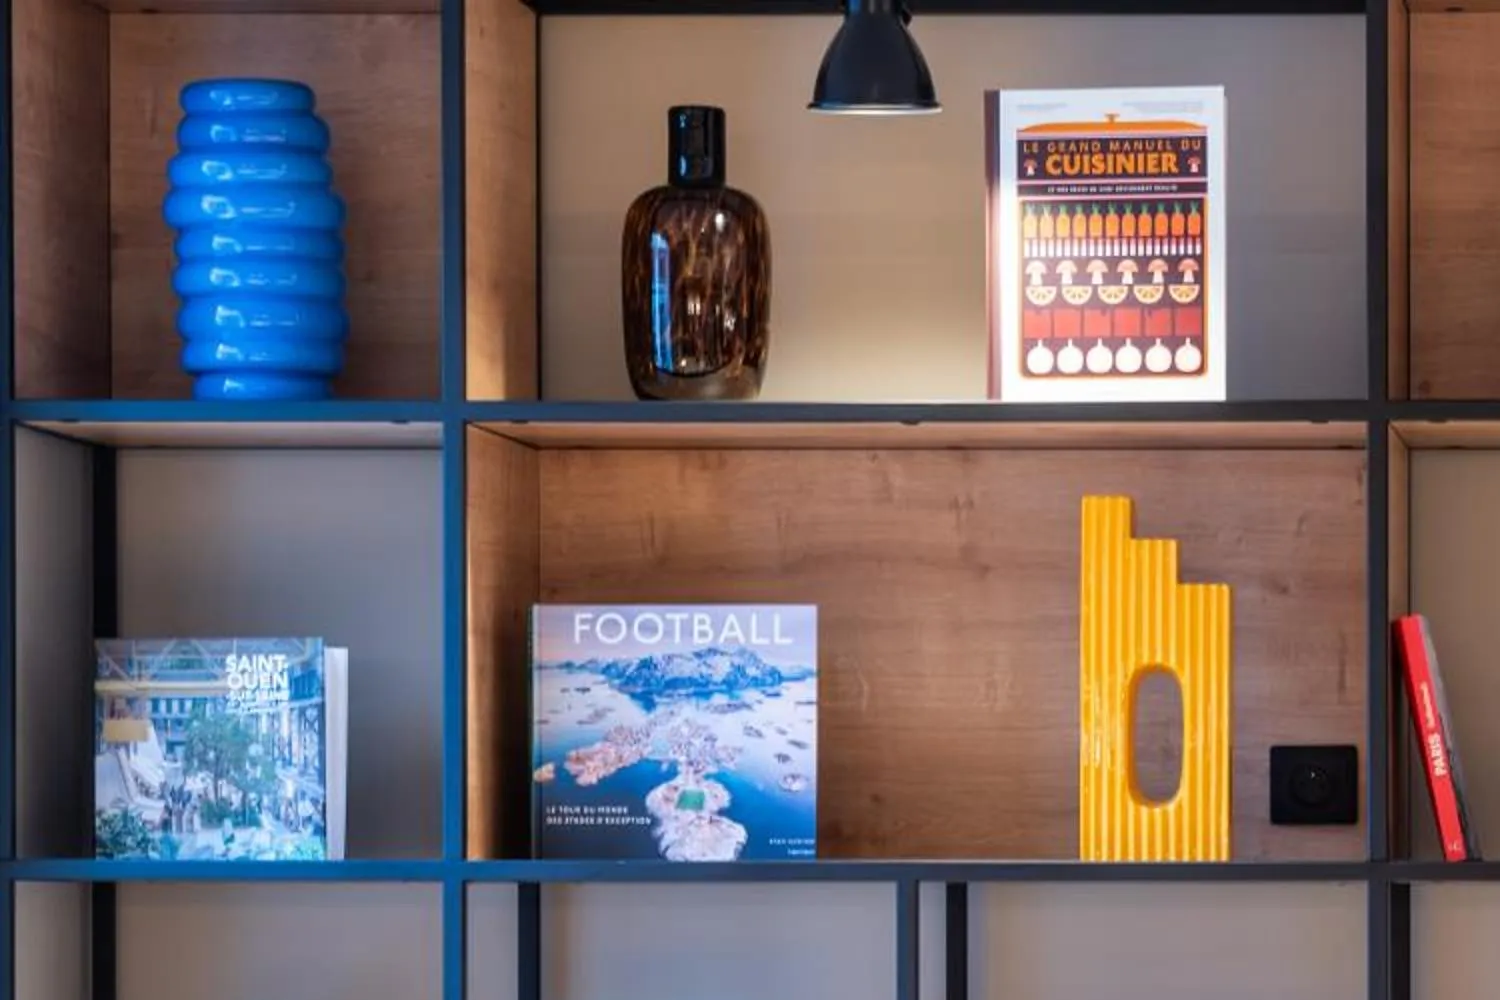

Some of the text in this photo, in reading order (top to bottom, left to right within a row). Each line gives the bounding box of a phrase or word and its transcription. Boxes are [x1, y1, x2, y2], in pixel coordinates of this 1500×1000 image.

[1023, 139, 1201, 153] LE GRAND MANUEL DU
[1045, 152, 1179, 175] CUISINIER
[574, 613, 793, 645] FOOTBALL
[227, 671, 289, 690] OUEN
[1428, 733, 1448, 777] PARIS
